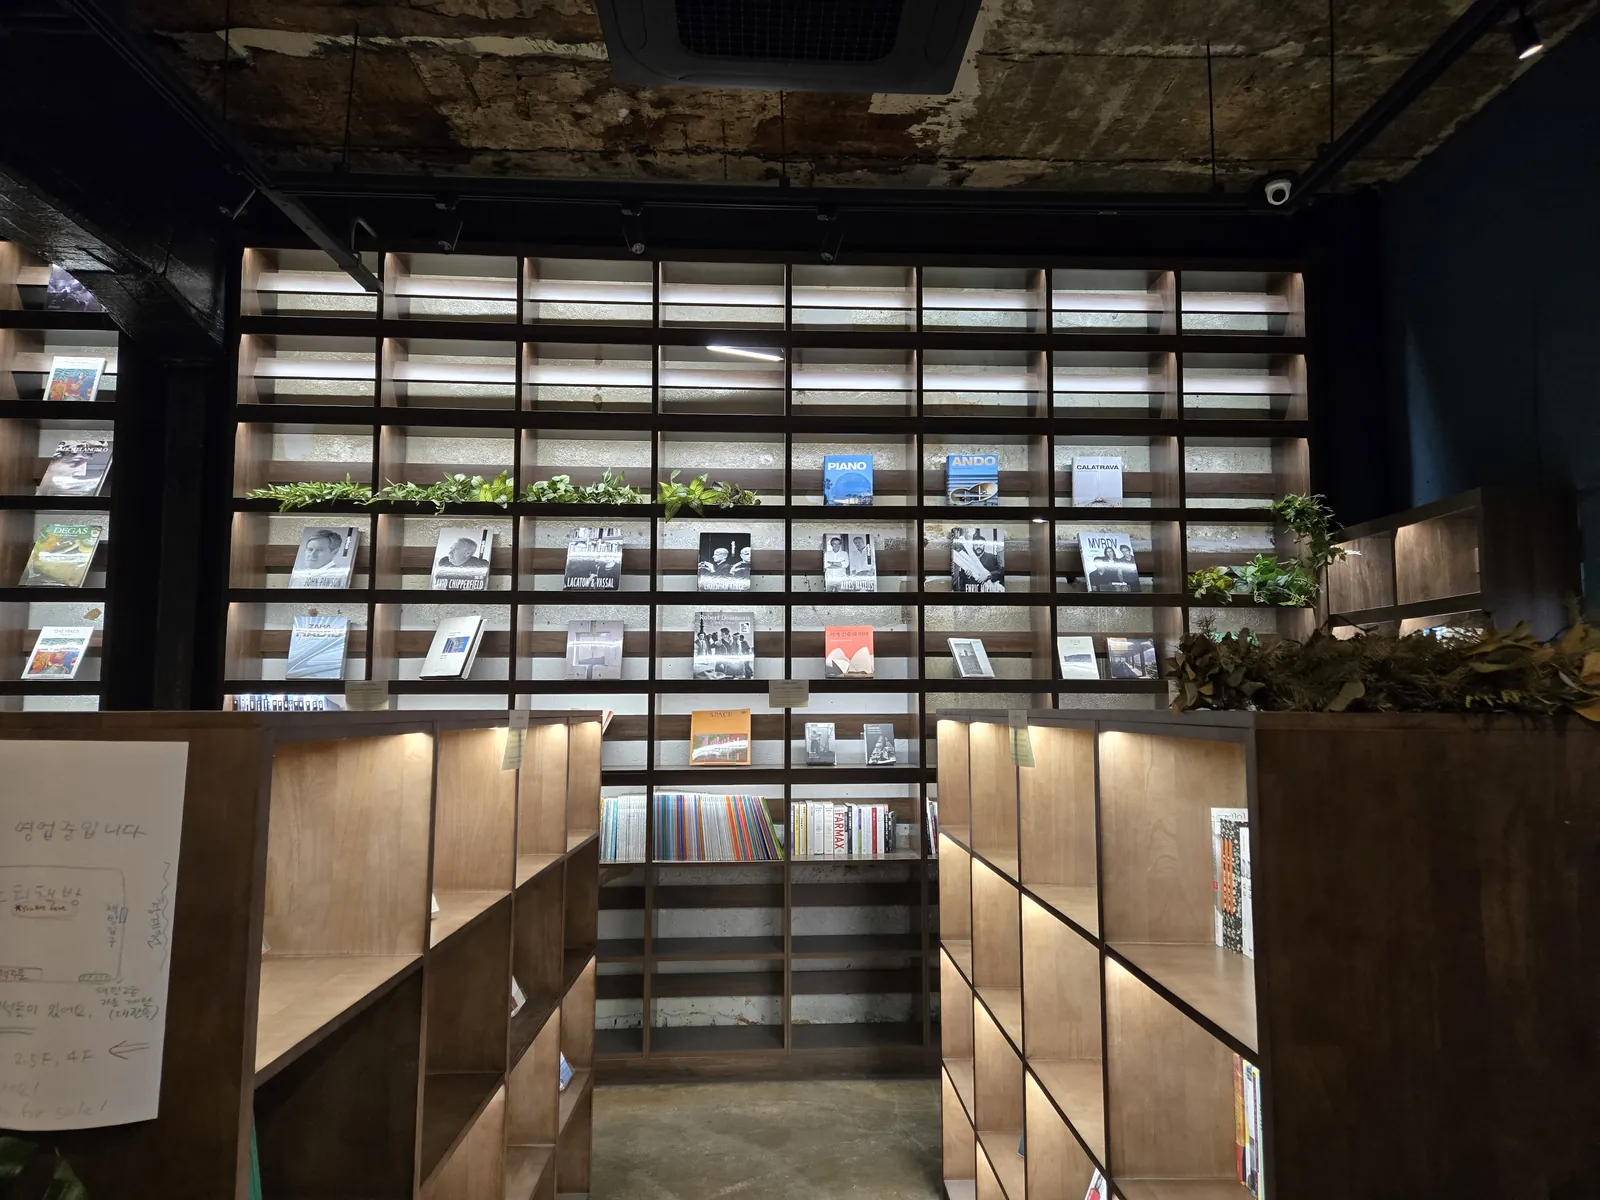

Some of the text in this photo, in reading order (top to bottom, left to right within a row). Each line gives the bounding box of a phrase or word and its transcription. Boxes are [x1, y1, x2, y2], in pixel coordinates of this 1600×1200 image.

[827, 461, 867, 471] PIANO
[951, 456, 996, 466] ANDO
[53, 526, 89, 534] DEGAS
[1087, 537, 1118, 549] MVRDV
[304, 577, 343, 588] JOHN PAWSON
[449, 578, 484, 590] CHIPPERFIELD
[596, 577, 614, 588] VASSAL
[834, 812, 845, 850] FARMAX
